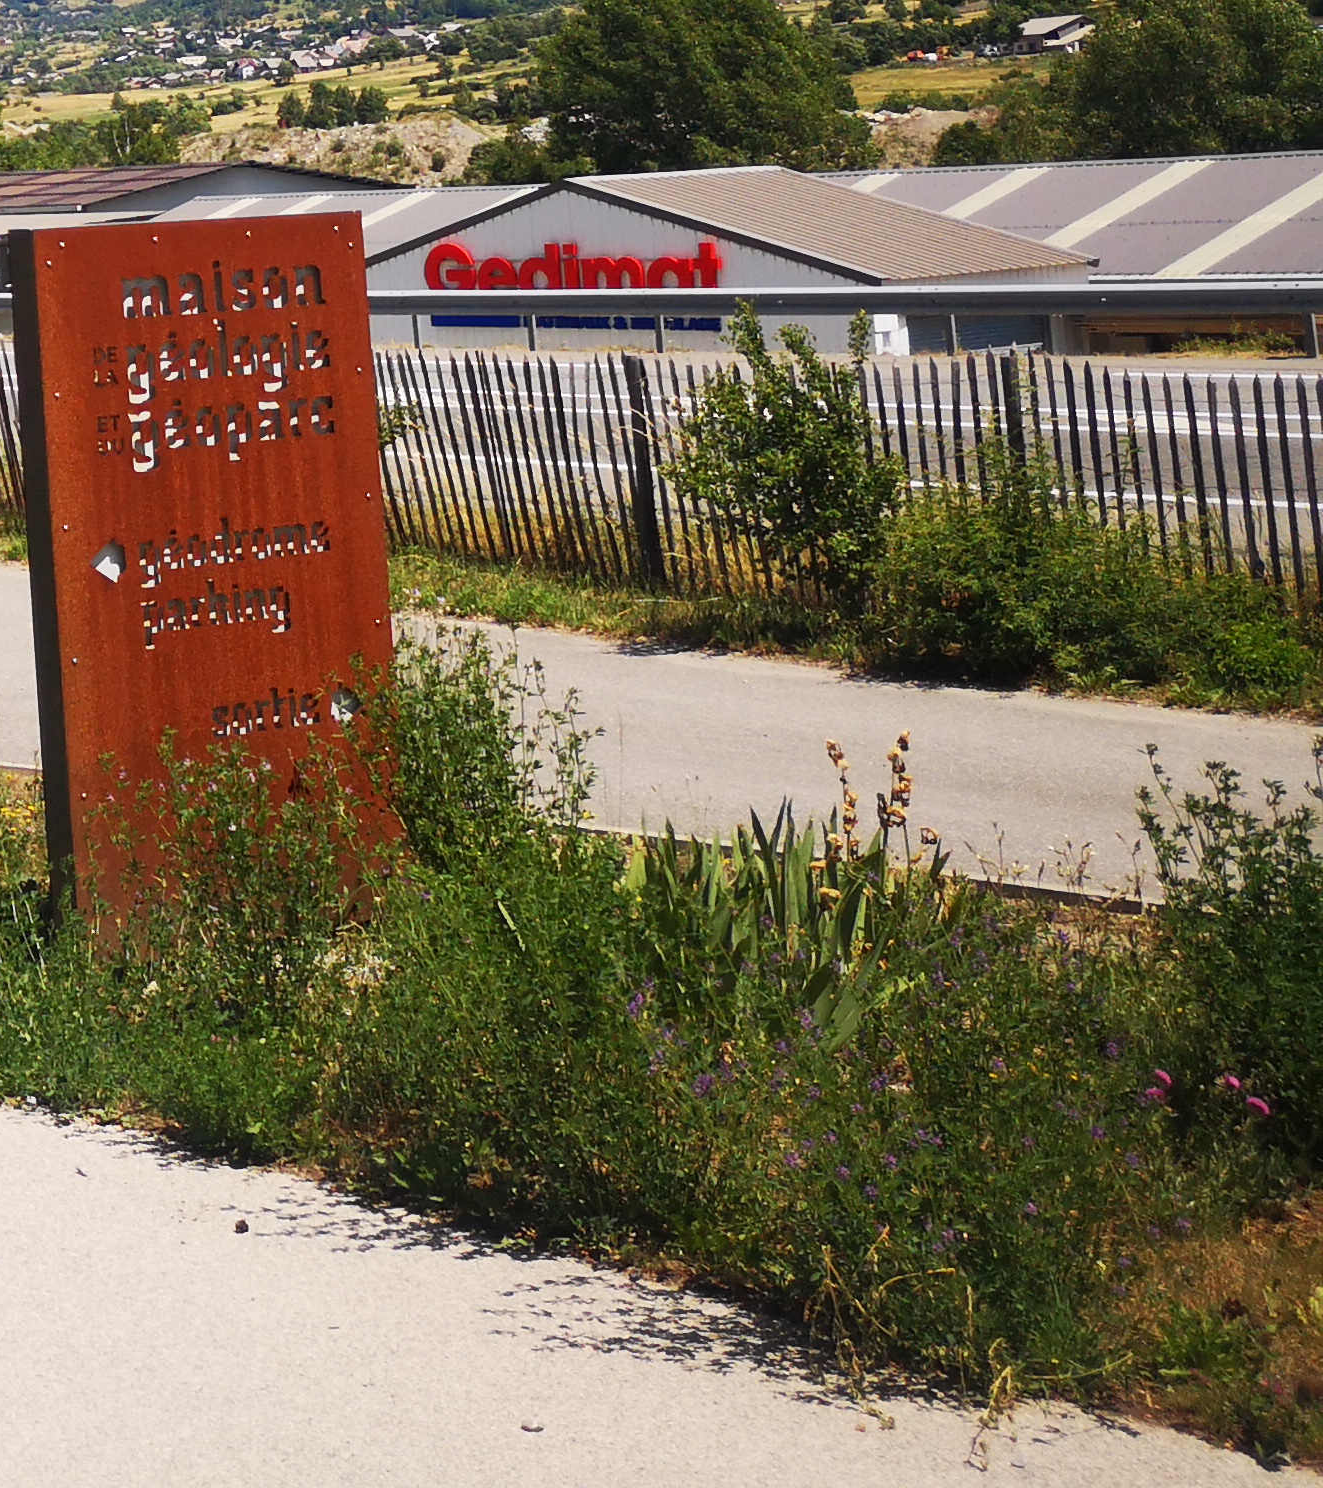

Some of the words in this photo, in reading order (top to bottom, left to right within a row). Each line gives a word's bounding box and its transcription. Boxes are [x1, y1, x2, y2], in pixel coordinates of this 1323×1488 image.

[121, 260, 326, 319] maison
[423, 240, 722, 290] Gedimat
[93, 346, 118, 365] DE
[94, 370, 119, 388] LA
[126, 318, 331, 405] géologie
[97, 414, 121, 434] ET
[98, 438, 125, 457] DU
[127, 394, 336, 473] géoparc
[137, 517, 331, 589] géodrome
[140, 578, 292, 651] parking
[211, 686, 321, 738] sortie
